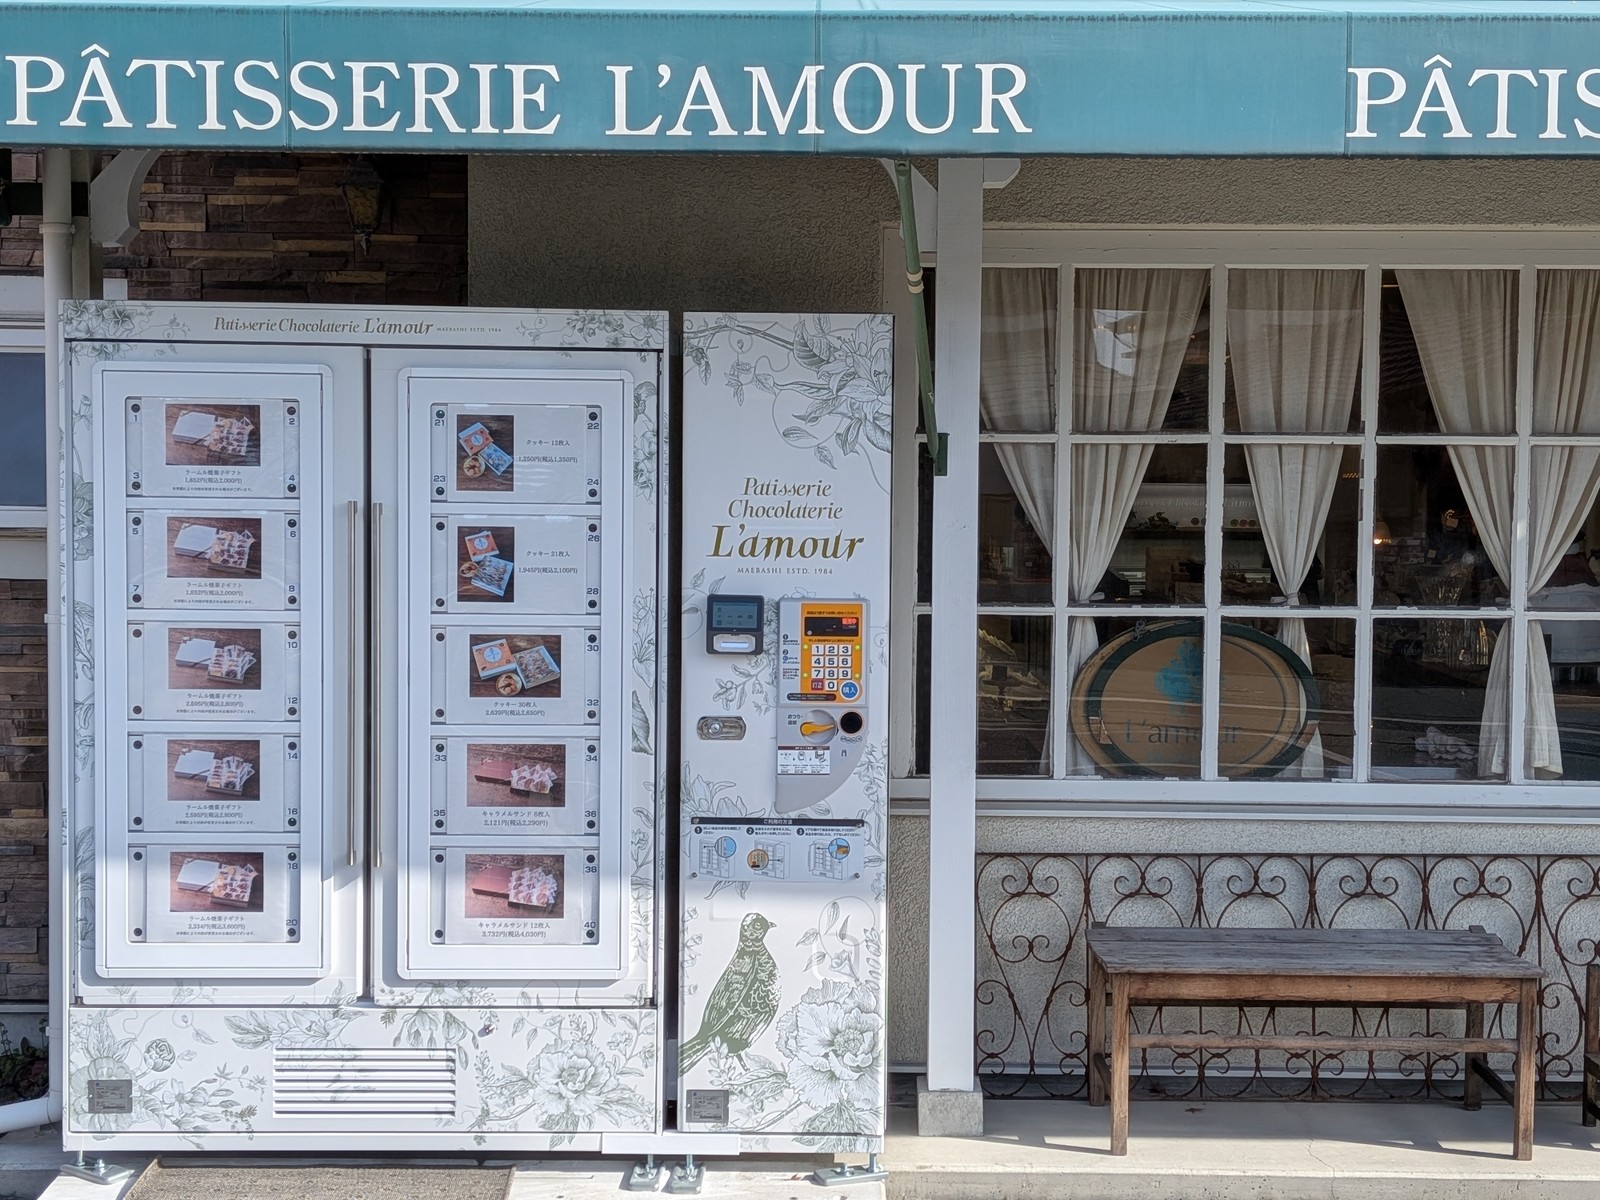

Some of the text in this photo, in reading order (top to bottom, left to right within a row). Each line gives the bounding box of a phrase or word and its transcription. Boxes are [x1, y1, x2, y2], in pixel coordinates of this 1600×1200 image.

[4, 43, 1033, 136] PÂTISSERIE L'AMOUR
[213, 316, 277, 332] Patisserie
[278, 318, 360, 333] Chocolaterie
[362, 317, 434, 335] L'amour
[434, 419, 445, 427] 21
[288, 474, 296, 482] 4
[434, 475, 446, 483] 23
[587, 478, 599, 486] 24
[741, 477, 832, 497] Patisserie
[728, 499, 843, 520] Chocolaterie
[290, 530, 297, 538] 6
[706, 523, 865, 562] L'amour
[133, 584, 140, 592] 7
[287, 641, 298, 649] 10
[433, 809, 446, 817] 35
[584, 810, 597, 818] 36
[288, 862, 298, 870] 18
